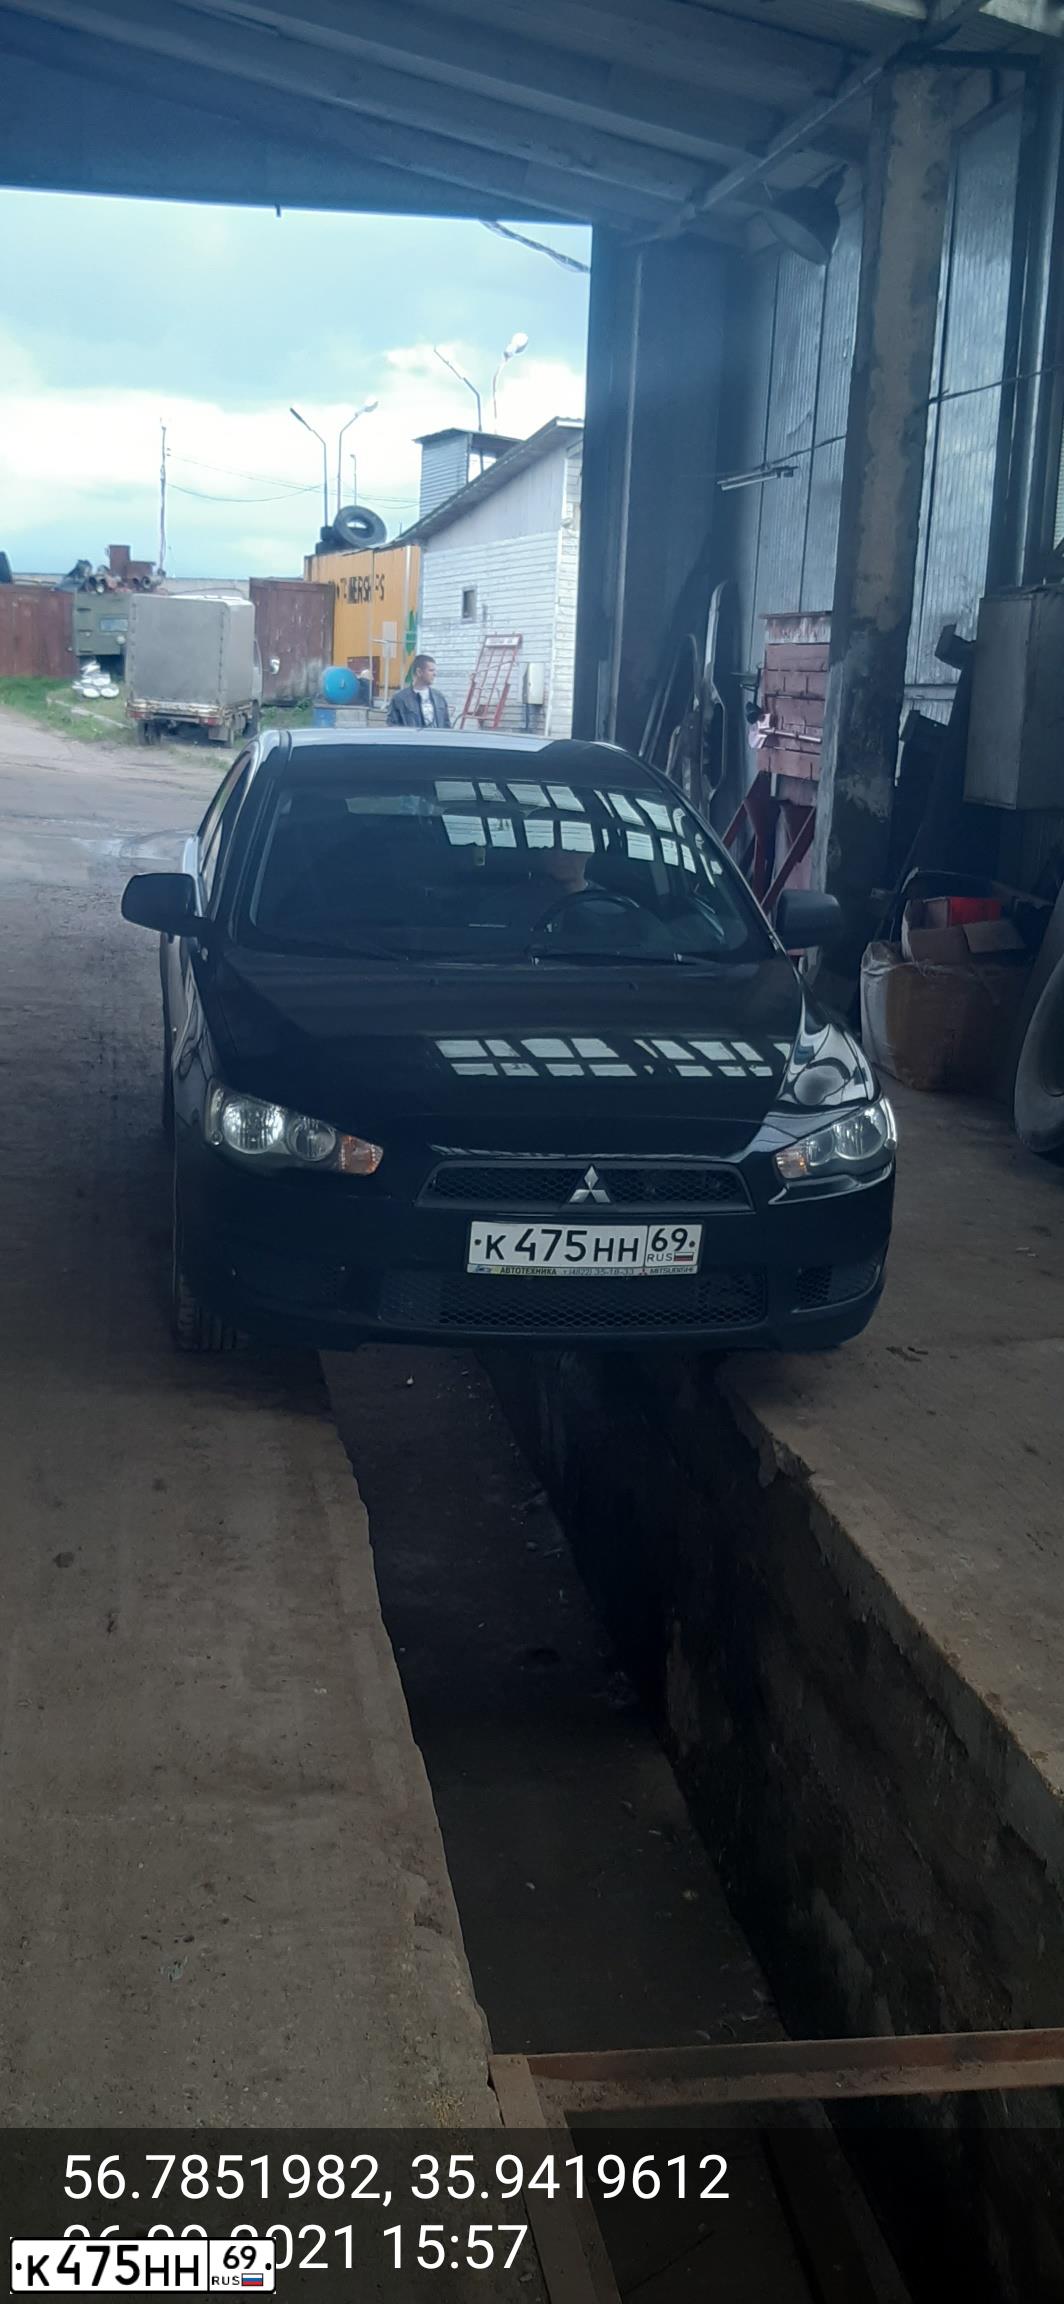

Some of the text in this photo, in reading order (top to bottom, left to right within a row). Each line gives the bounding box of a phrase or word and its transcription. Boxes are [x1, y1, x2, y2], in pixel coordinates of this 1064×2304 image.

[651, 1228, 688, 1252] 69
[647, 1253, 673, 1262] RUS
[500, 1266, 557, 1275] АВТОТЕХНИКА
